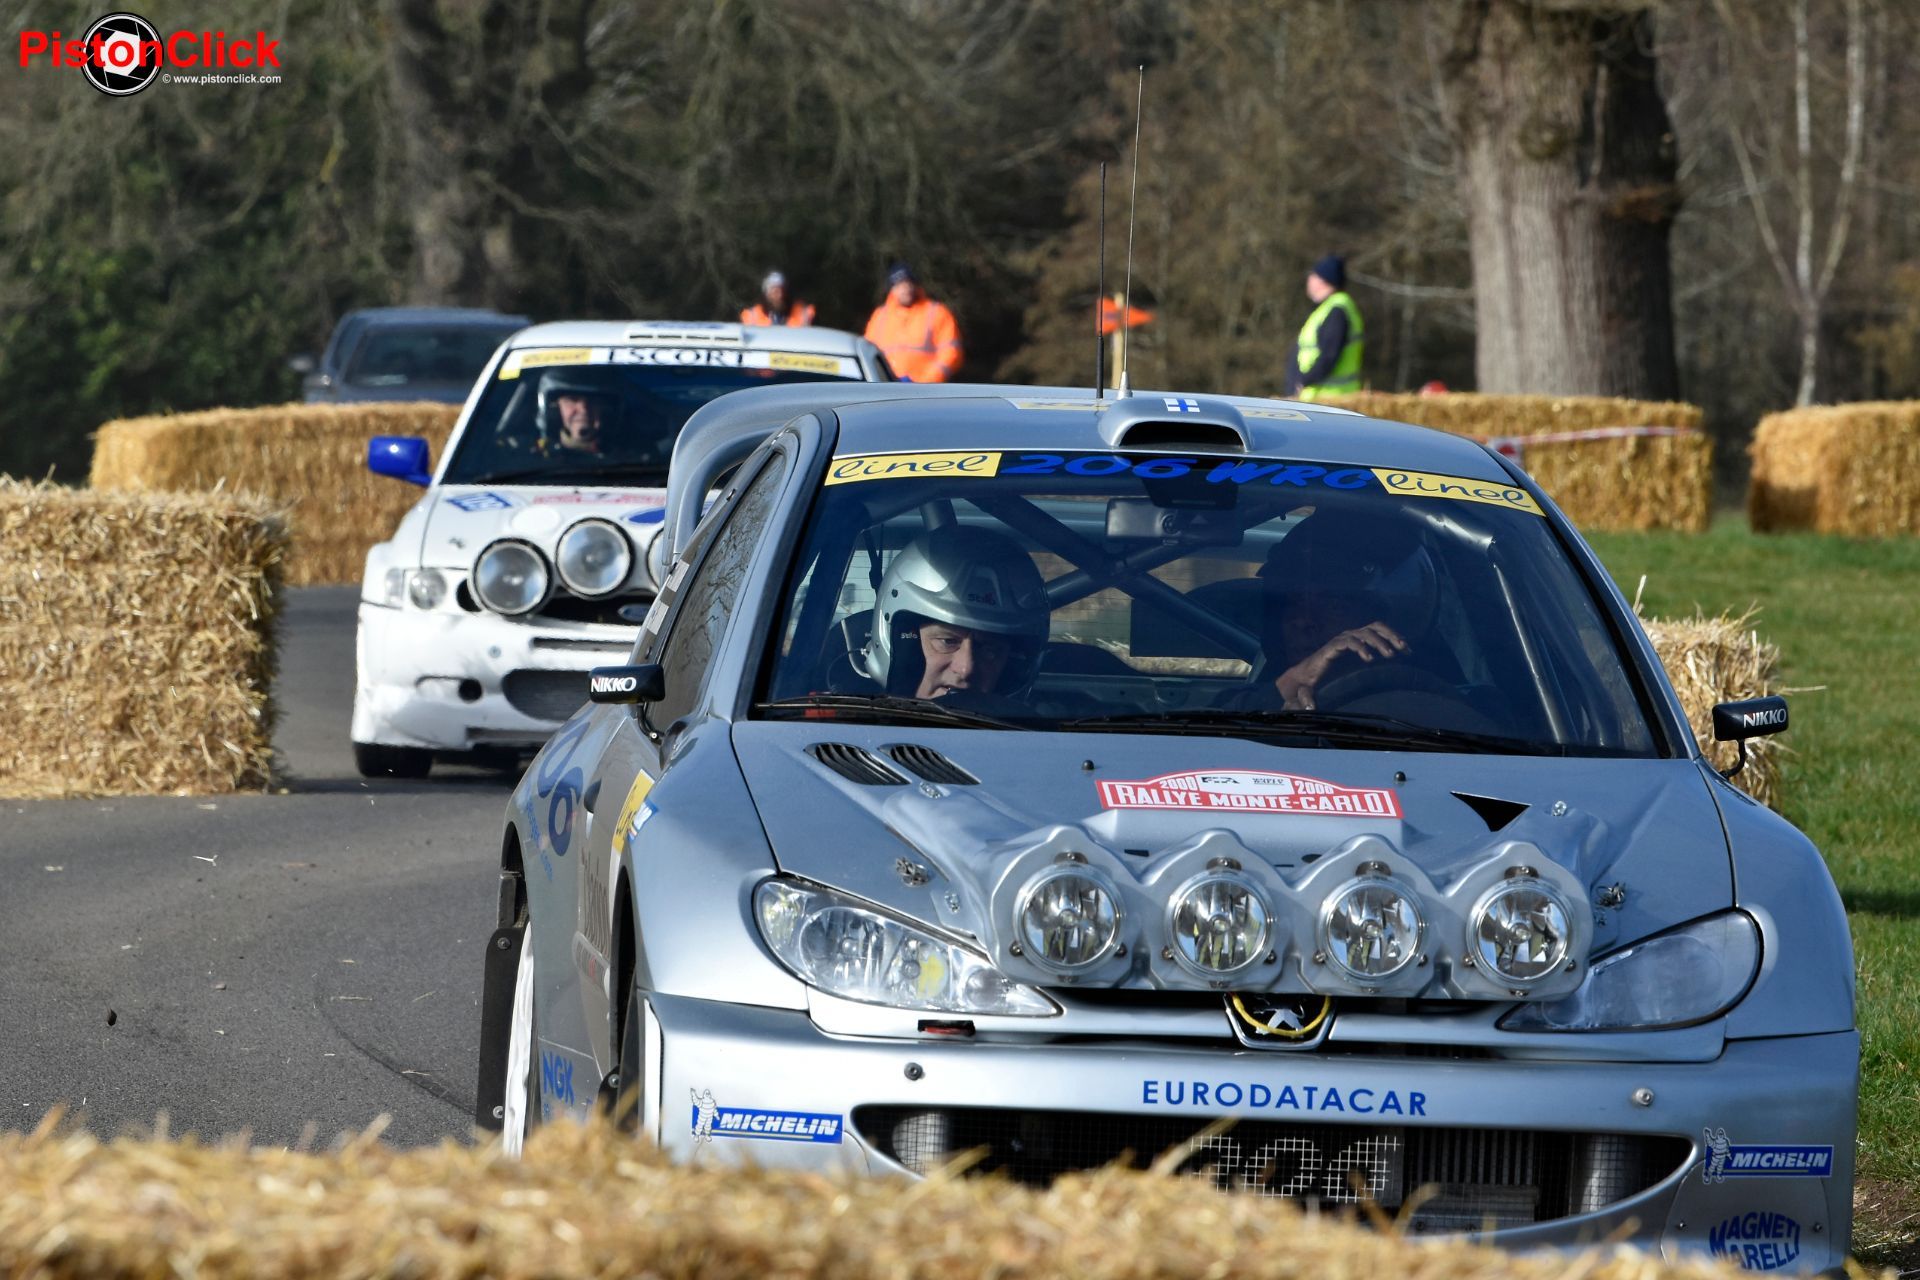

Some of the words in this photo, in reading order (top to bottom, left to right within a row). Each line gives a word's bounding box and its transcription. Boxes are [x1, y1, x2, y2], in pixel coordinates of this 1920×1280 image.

[607, 348, 745, 367] ESCORT
[833, 455, 989, 479] linel
[1000, 454, 1197, 479] 206
[1206, 460, 1375, 489] WRC
[1386, 473, 1533, 507] linel
[590, 677, 637, 692] NIKKO
[1743, 708, 1787, 728] NIKKO
[1160, 775, 1198, 791] 2000
[1295, 781, 1334, 795] 2000
[1114, 784, 1202, 806] RALLYE
[1210, 793, 1384, 813] MONTE-CARLO
[542, 1050, 575, 1106] NGK
[1142, 1080, 1427, 1116] EURODATACAR
[719, 1113, 838, 1136] MICHELIN
[1731, 1152, 1829, 1168] MICHELIN
